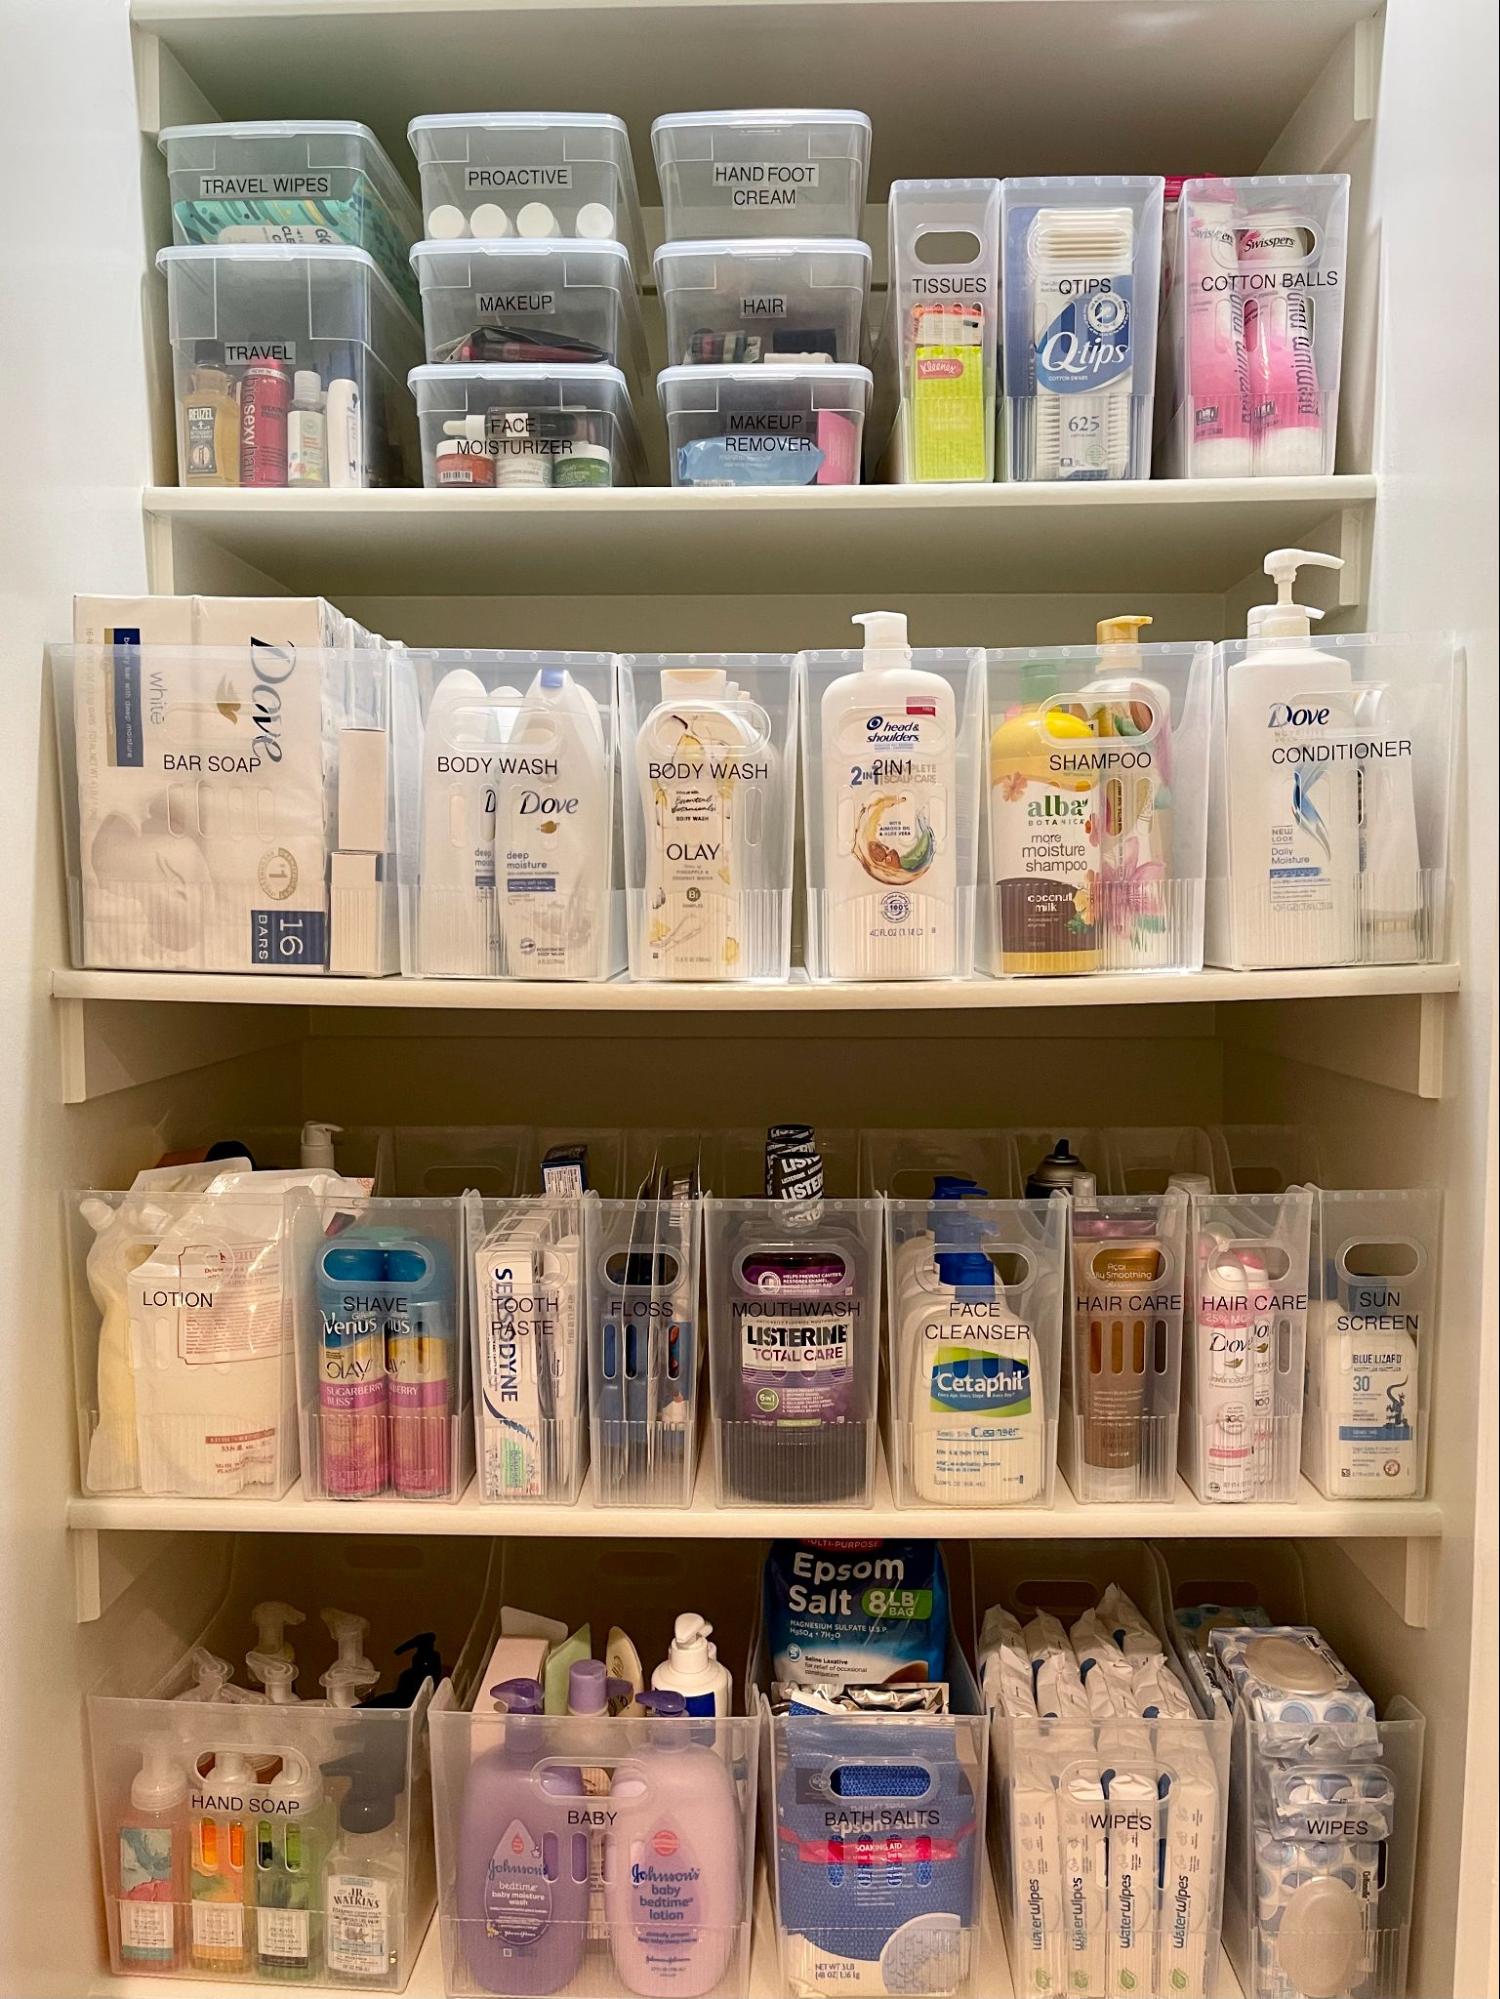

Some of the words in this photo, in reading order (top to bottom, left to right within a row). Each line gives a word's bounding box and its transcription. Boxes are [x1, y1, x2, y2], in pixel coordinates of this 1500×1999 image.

[467, 168, 568, 186] PROACTIVE
[714, 166, 764, 182] HAND
[768, 166, 816, 183] FOOT
[202, 178, 269, 194] TRAVEL
[273, 176, 329, 193] WIPES
[733, 189, 796, 206] CREAM
[1243, 236, 1296, 252] Swisspers
[912, 278, 987, 293] TISSUES
[1058, 279, 1112, 295] QTIPS
[1201, 274, 1276, 291] COTTON
[1282, 271, 1338, 287] BALLS
[480, 294, 553, 312] MAKEUP
[743, 298, 784, 314] HAIR
[226, 345, 293, 360] TRAVEL
[491, 418, 537, 433] FACE
[730, 415, 803, 429] MAKEUP
[1068, 416, 1101, 432] 625
[457, 440, 573, 455] MOISTURIZER
[725, 437, 811, 452] REMOVER
[149, 671, 168, 726] white
[250, 636, 298, 763] Dove
[1268, 702, 1330, 728] Dove
[883, 722, 912, 732] head
[912, 723, 919, 732] &
[867, 732, 920, 743] shoulders
[1272, 740, 1412, 765] CONDITIONER
[163, 754, 202, 771] BAR
[208, 755, 262, 773] SOAP
[437, 756, 494, 774] BODY
[498, 758, 558, 775] WASH
[873, 759, 912, 776] 2IN1
[1049, 752, 1152, 771] SHAMPOO
[649, 763, 704, 779] BODY
[709, 762, 768, 779] WASH
[519, 790, 579, 815] Dove
[1027, 795, 1088, 817] alba
[1031, 834, 1061, 843] more
[507, 851, 529, 860] deep
[666, 843, 720, 861] OLAY
[1022, 845, 1085, 858] moisture
[1272, 848, 1293, 856] Daily
[507, 861, 547, 869] moisture
[1026, 859, 1088, 874] shampoo
[258, 915, 268, 960] BARS
[279, 918, 303, 956] 16
[1106, 1271, 1152, 1280] Smoothing
[142, 1290, 213, 1308] LOTION
[343, 1296, 408, 1313] SHAVE
[491, 1298, 559, 1313] TOOTH
[1076, 1296, 1122, 1311] HAIR
[1128, 1295, 1182, 1311] CARE
[1202, 1296, 1248, 1311] HAIR
[1254, 1295, 1307, 1310] CARE
[1360, 1292, 1401, 1307] SUN
[611, 1302, 674, 1317] FLOSS
[732, 1301, 860, 1317] MOUTHWASH
[949, 1302, 1001, 1318] FACE
[320, 1309, 378, 1335] Venus
[491, 1320, 554, 1336] PASTE
[1337, 1315, 1418, 1331] SCREEN
[495, 1268, 519, 1402] SENSODYNE
[747, 1324, 847, 1347] LISTERINE
[925, 1324, 1031, 1341] CLEANSER
[753, 1348, 801, 1361] TOTAL
[804, 1347, 843, 1361] CARE
[1353, 1354, 1372, 1364] BLUE
[1374, 1354, 1402, 1363] LIZARD
[937, 1370, 1025, 1398] Cetaphil
[1353, 1375, 1370, 1392] 30
[803, 1538, 879, 1549] ULTI-PURPOSE
[793, 1552, 904, 1585] Epsom
[789, 1584, 852, 1616] Salt
[868, 1590, 887, 1614] 8
[889, 1591, 914, 1607] LB
[889, 1608, 914, 1617] BAG
[790, 1620, 833, 1631] MAGNESIUM
[834, 1623, 866, 1632] SULFATE
[805, 1655, 823, 1664] Saline
[192, 1795, 243, 1812] HAND
[249, 1798, 300, 1815] SOAP
[568, 1810, 618, 1826] BABY
[825, 1811, 874, 1826] BATH
[881, 1810, 940, 1824] SALTS
[1090, 1814, 1152, 1830] WIPES
[1307, 1820, 1369, 1836] WIPES
[632, 1863, 700, 1889] Johnson's
[492, 1891, 510, 1899] baby
[511, 1892, 545, 1900] moisture
[651, 1884, 681, 1898] baby
[333, 1896, 380, 1909] WATKINS
[640, 1896, 693, 1908] bedtime
[650, 1909, 684, 1921] lotion
